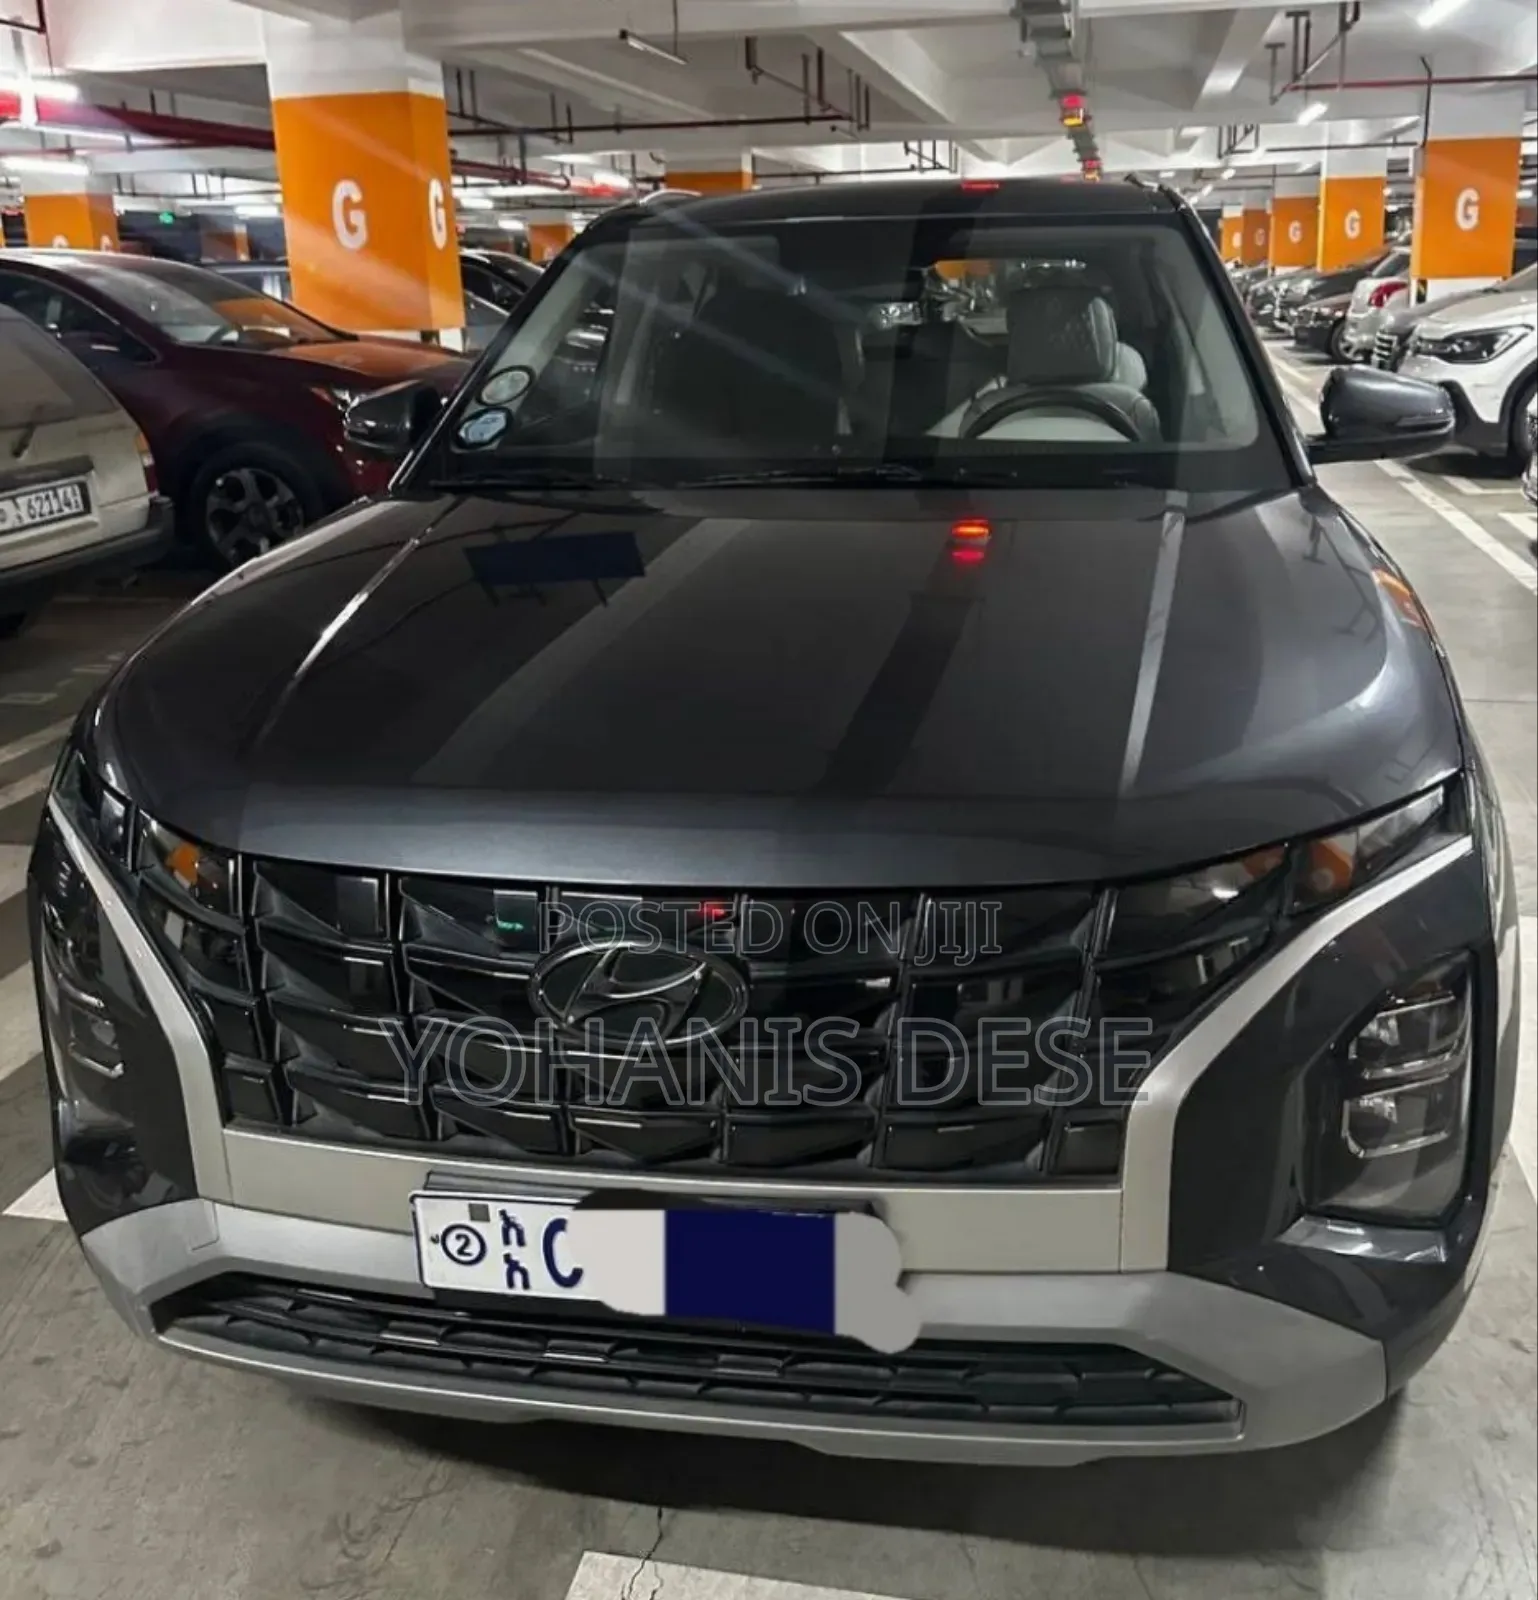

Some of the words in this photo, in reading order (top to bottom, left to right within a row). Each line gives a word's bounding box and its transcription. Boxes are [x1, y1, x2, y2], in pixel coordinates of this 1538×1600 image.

[332, 179, 368, 250] G
[428, 178, 448, 250] G
[1344, 209, 1361, 239] G
[1456, 187, 1480, 231] G
[1288, 220, 1303, 244] G
[455, 1234, 473, 1257] 2
